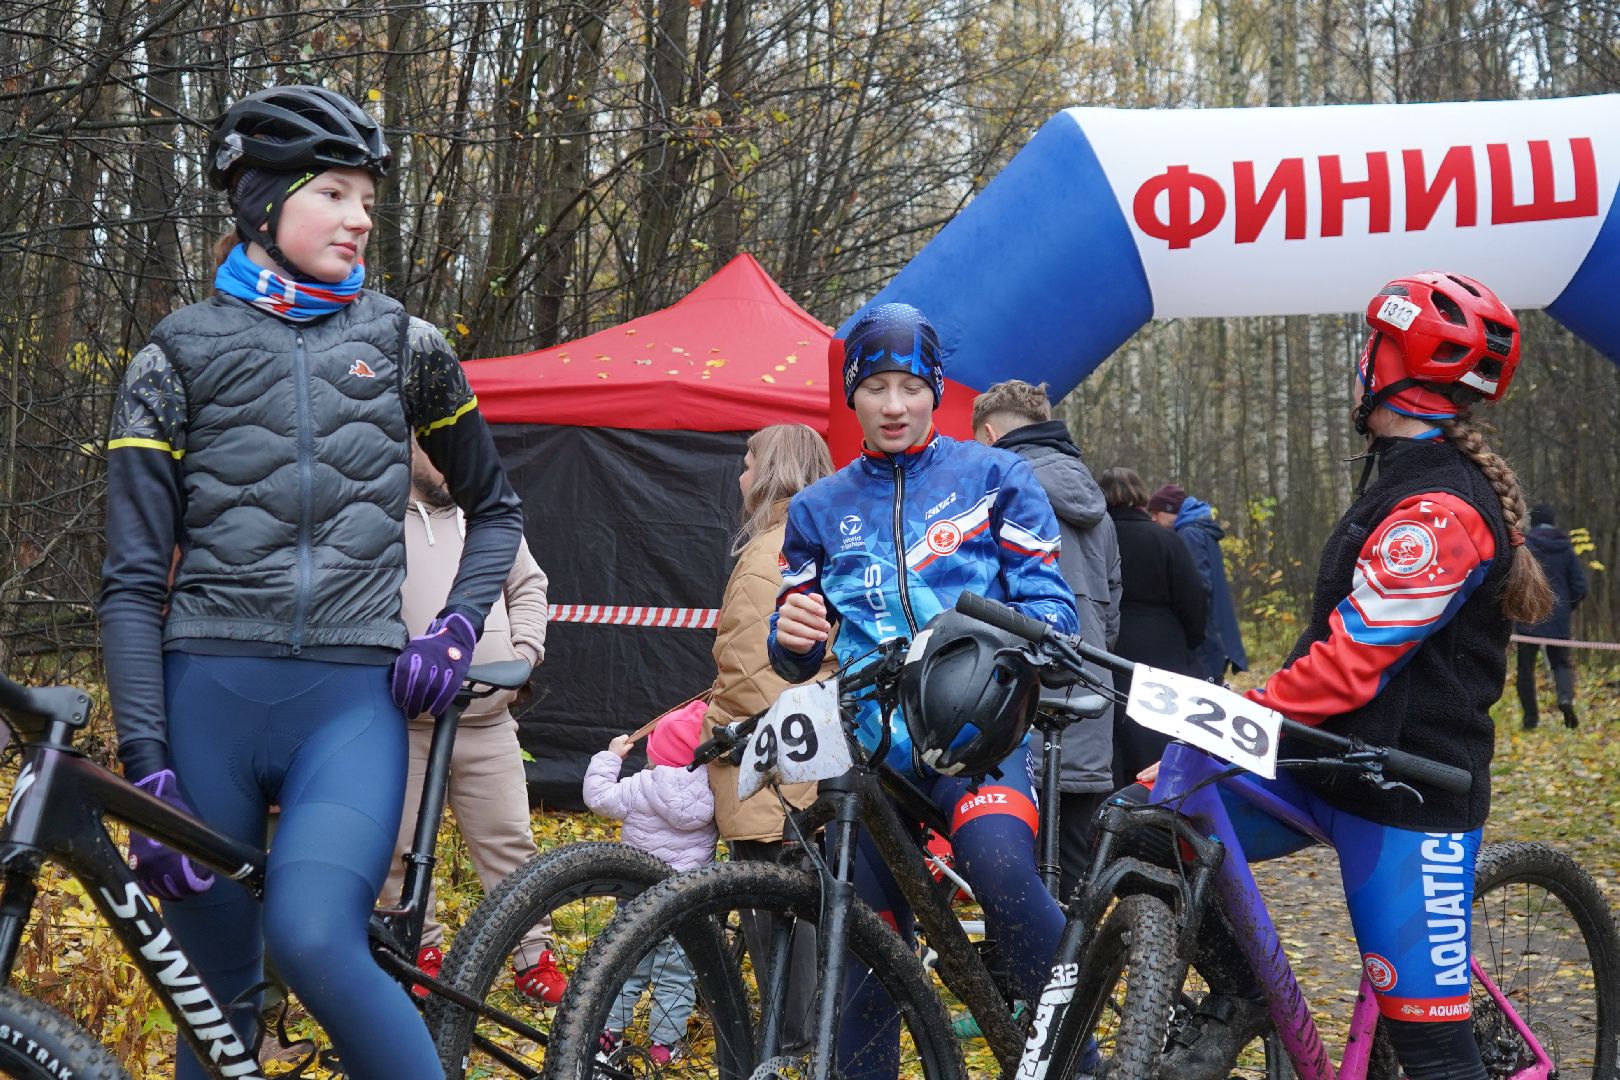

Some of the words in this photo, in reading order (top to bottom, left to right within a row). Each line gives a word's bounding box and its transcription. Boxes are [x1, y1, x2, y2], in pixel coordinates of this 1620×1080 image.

[1133, 137, 1599, 250] ФИНИШ
[864, 563, 900, 640] TICS
[753, 713, 819, 773] 99
[1137, 682, 1269, 757] 329
[1421, 832, 1468, 986] AQUATIC
